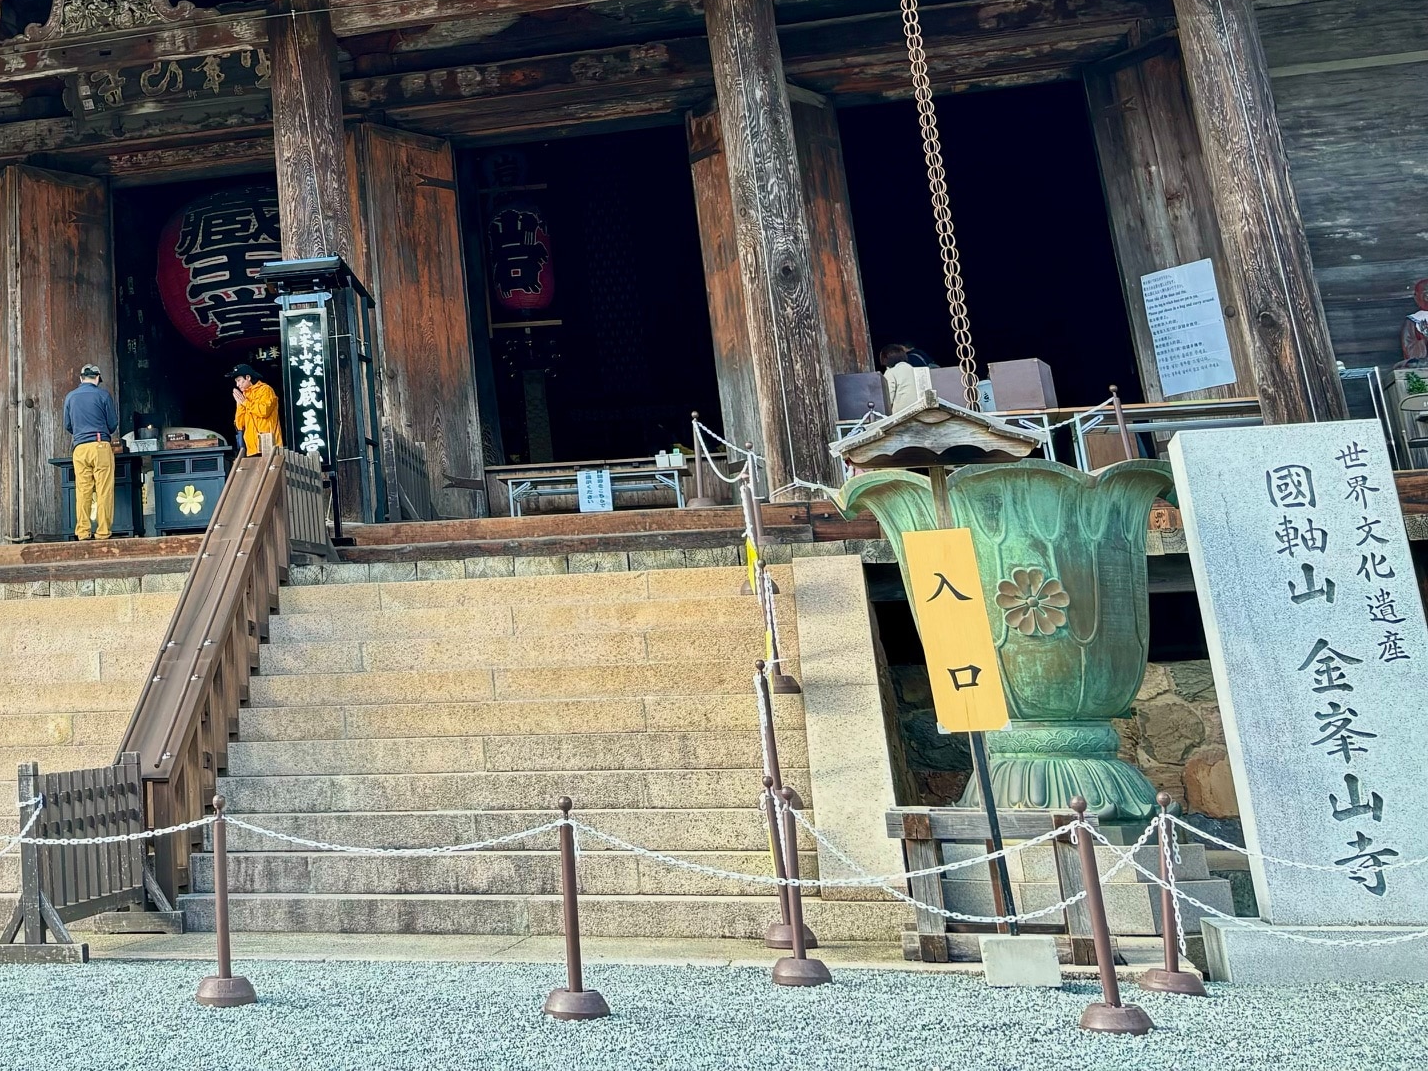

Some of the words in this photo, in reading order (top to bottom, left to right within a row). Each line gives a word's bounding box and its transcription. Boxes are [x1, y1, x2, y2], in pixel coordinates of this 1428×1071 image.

[1266, 464, 1337, 605] 國軸山
[1334, 441, 1411, 664] 世界文化遺産
[926, 572, 982, 692] 入口
[1297, 637, 1401, 898] 金峯山寺
